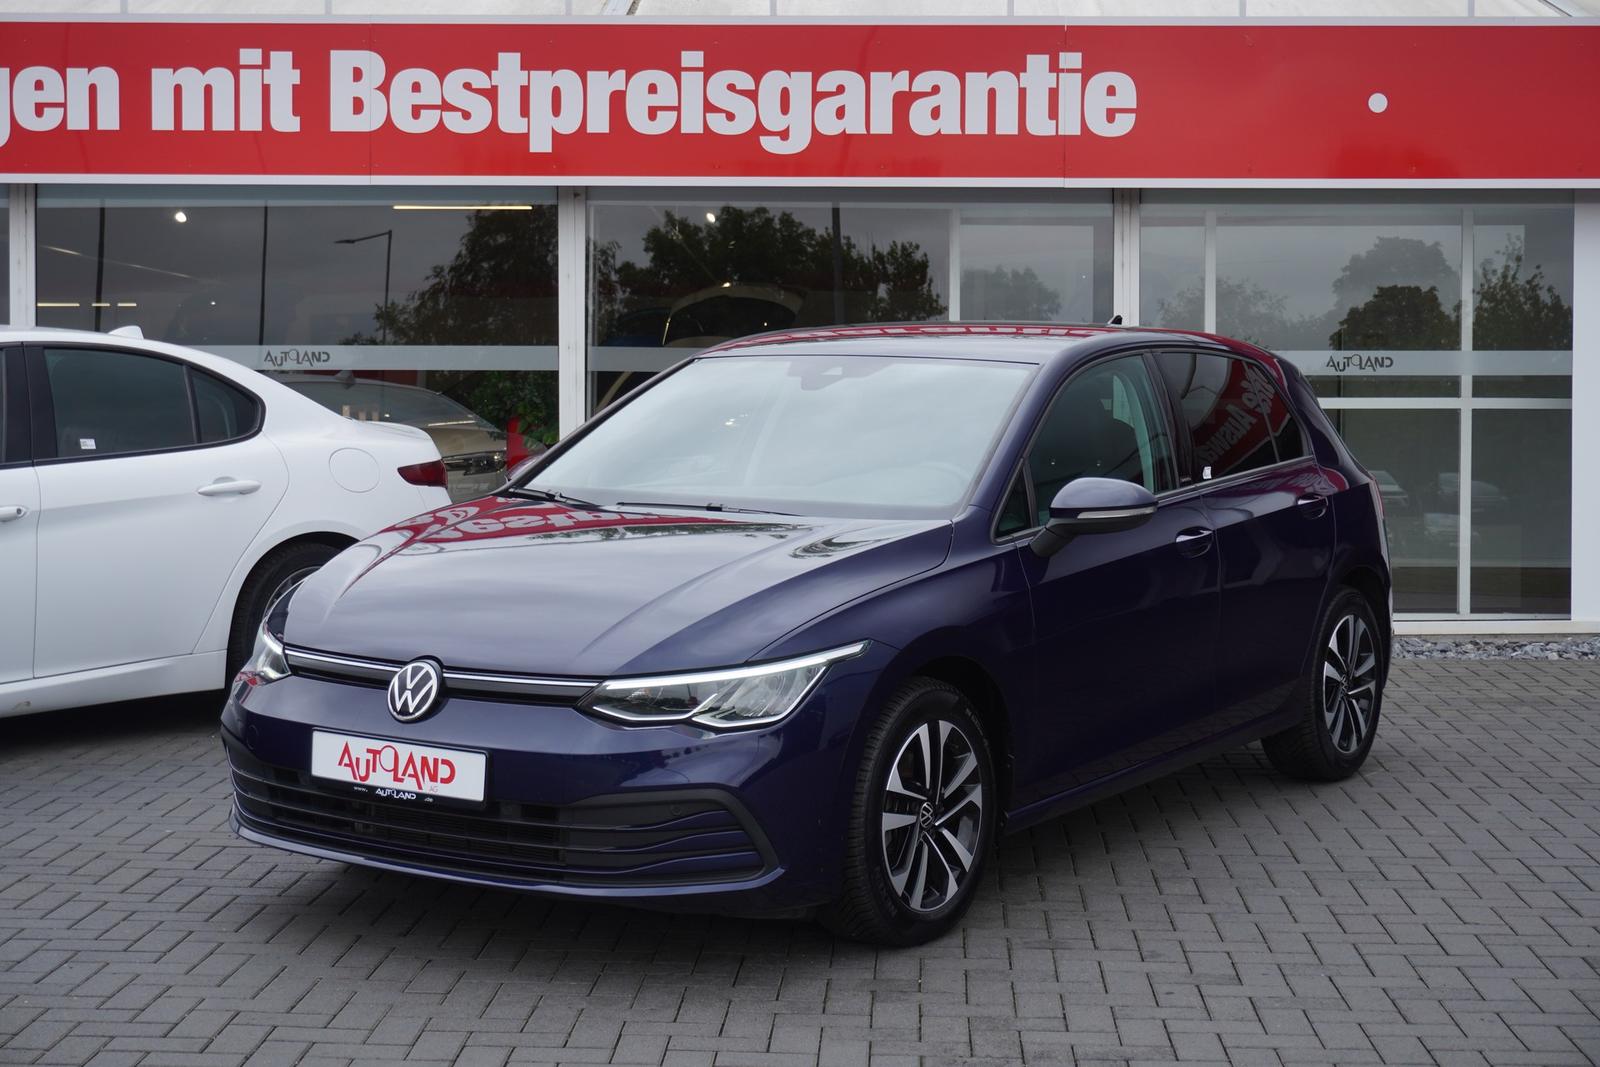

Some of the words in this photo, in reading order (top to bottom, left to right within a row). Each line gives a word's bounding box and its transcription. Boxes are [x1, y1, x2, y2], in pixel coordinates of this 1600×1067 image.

[0, 66, 120, 147] en
[151, 48, 300, 132] mit
[330, 49, 1137, 155] Bestpreisgarantie
